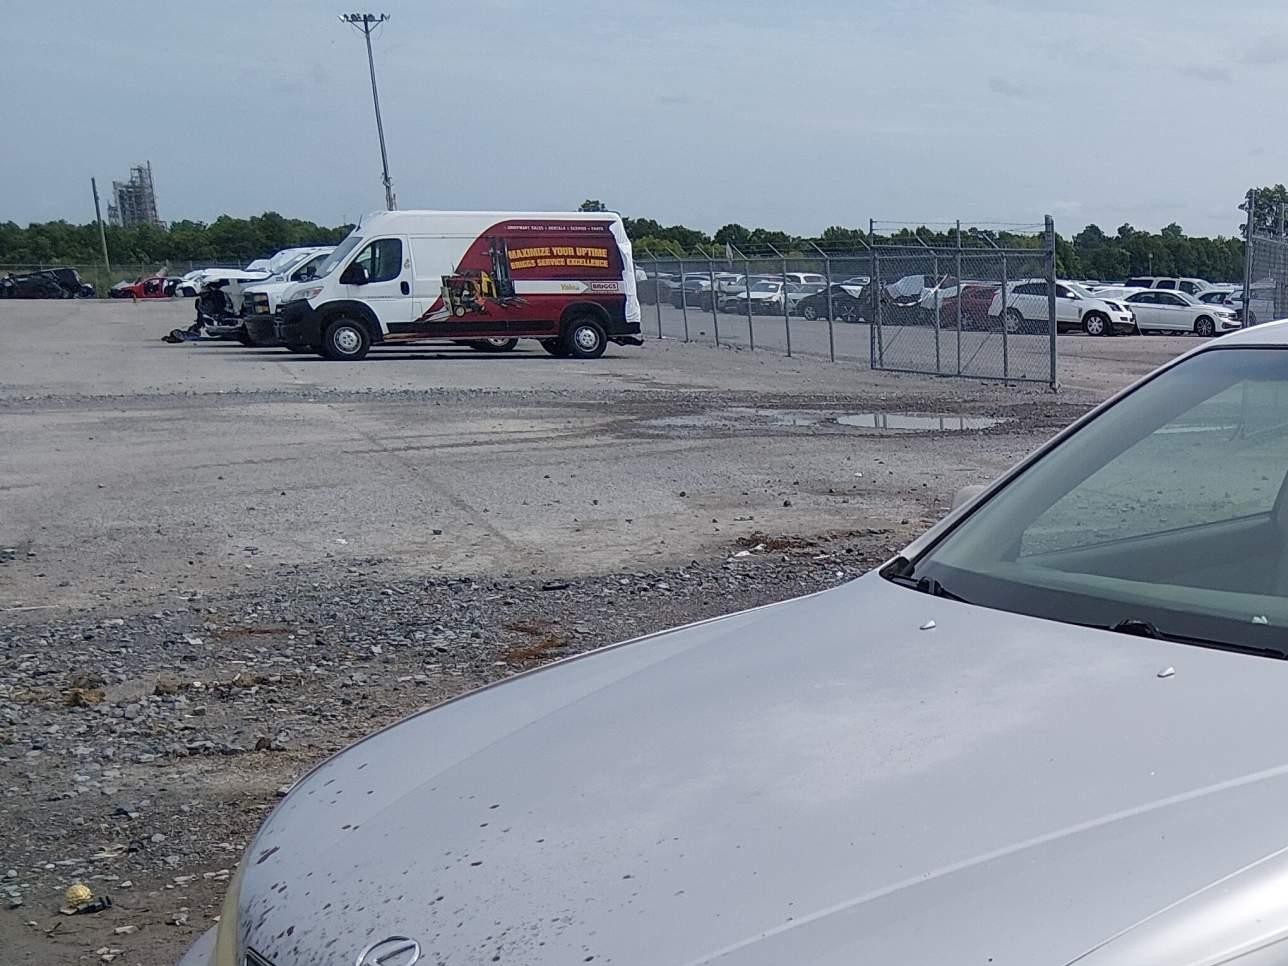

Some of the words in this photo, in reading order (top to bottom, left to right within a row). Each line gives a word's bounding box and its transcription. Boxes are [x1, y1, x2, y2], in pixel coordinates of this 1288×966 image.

[508, 248, 551, 259] MAXIMIZE
[551, 247, 574, 256] YOUR
[576, 247, 608, 258] UPTIME
[510, 260, 536, 270] BRIGGS
[537, 258, 565, 266] SERVICE
[566, 259, 609, 268] EXCELLENCE
